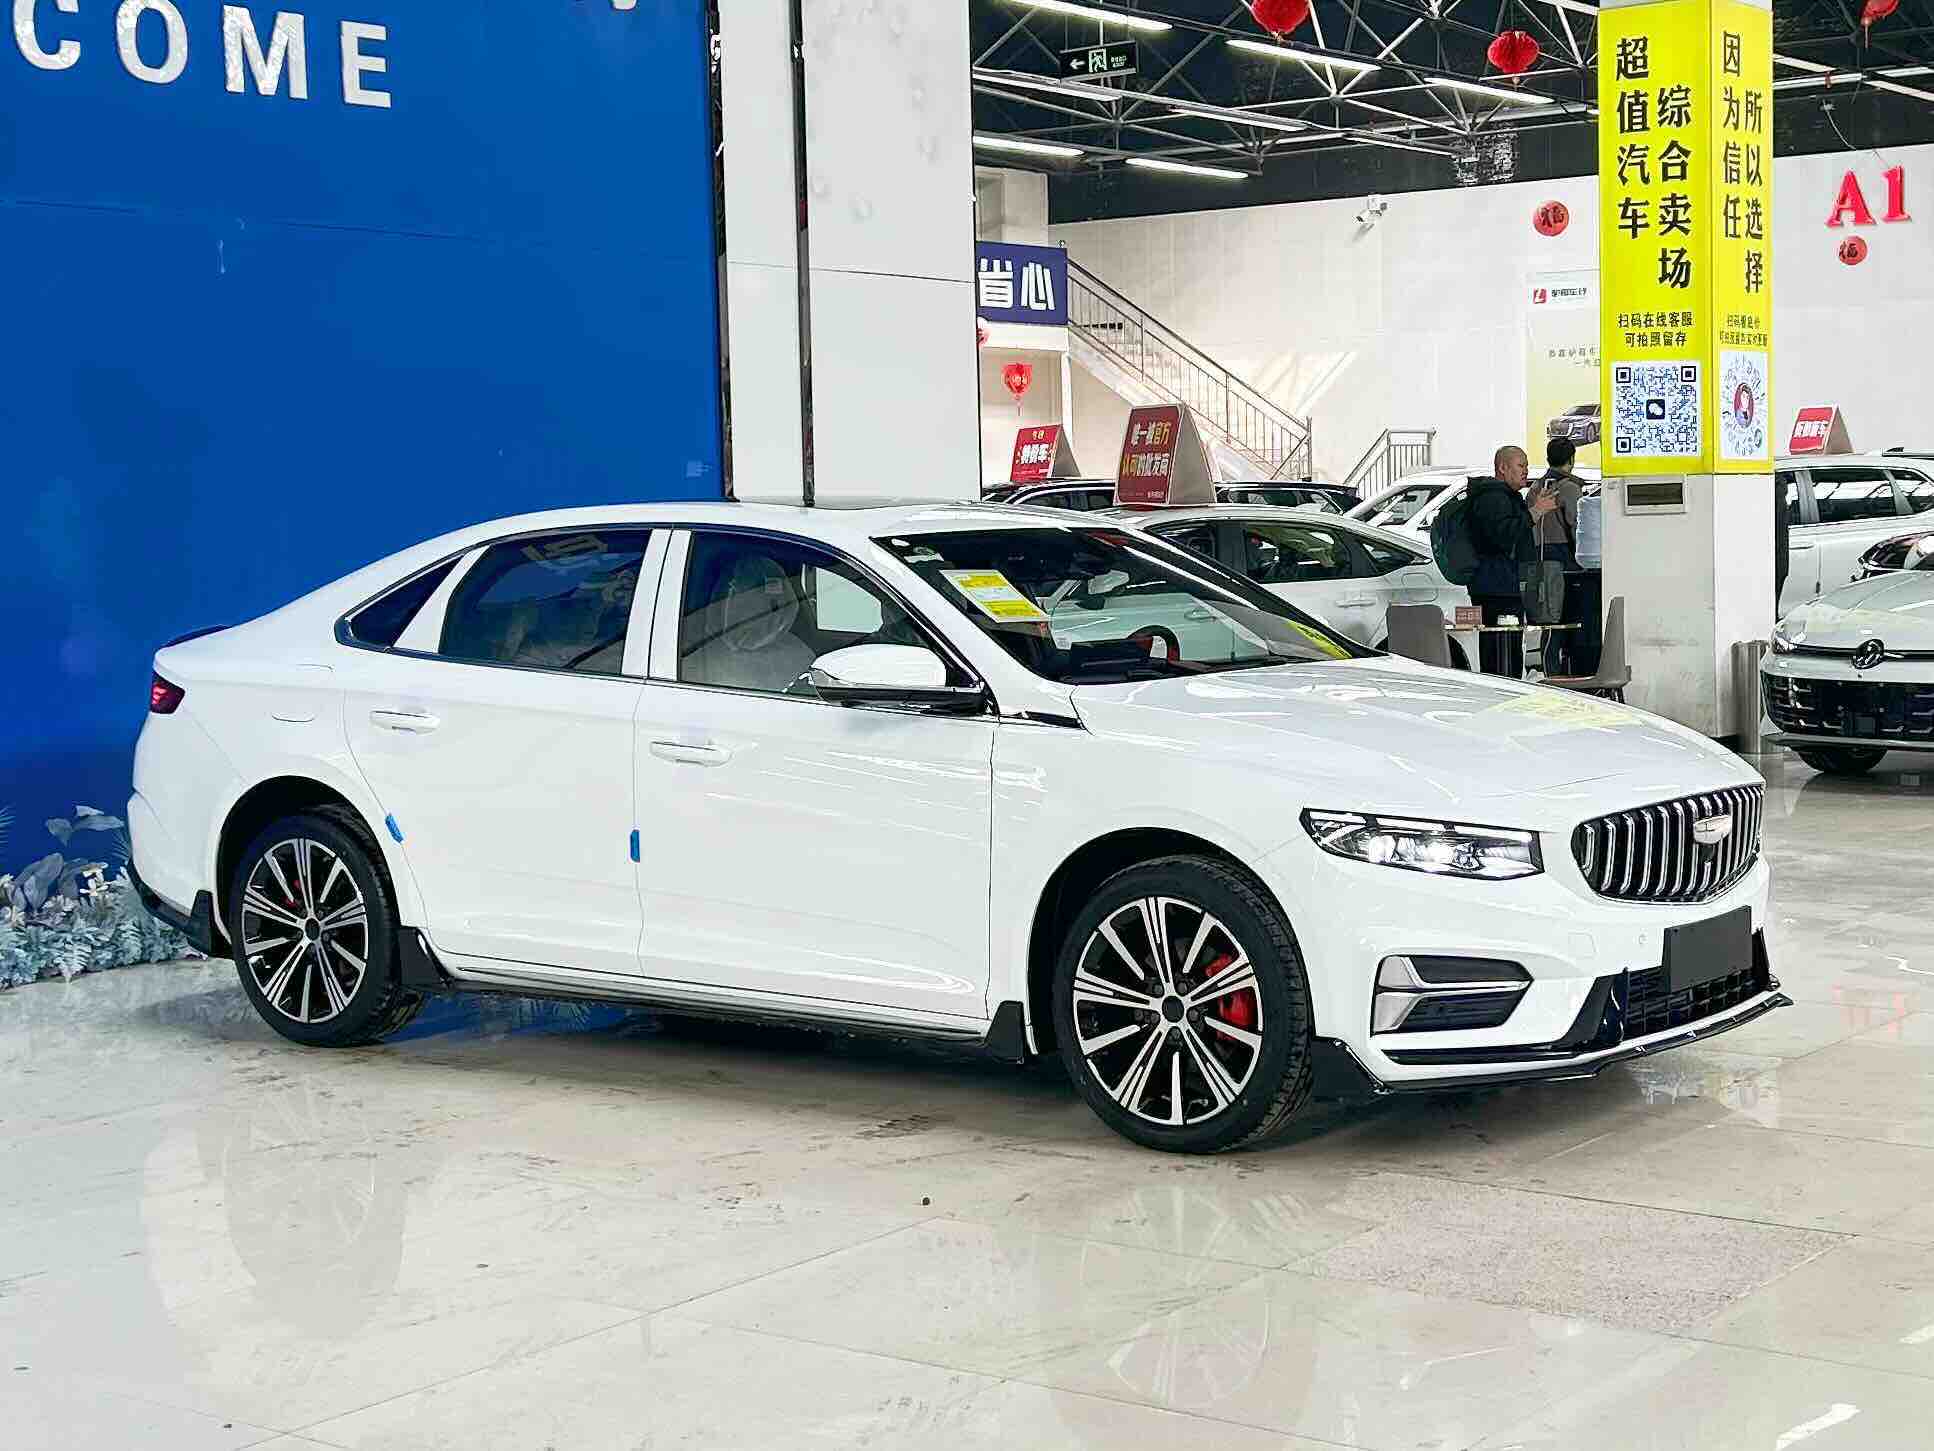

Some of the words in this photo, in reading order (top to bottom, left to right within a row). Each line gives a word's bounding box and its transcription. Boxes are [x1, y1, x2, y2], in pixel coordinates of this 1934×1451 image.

[13, 0, 391, 108] COME
[1616, 36, 1650, 239] 超值汽车
[1657, 84, 1692, 288] 综合卖场
[1723, 30, 1741, 240] 因为信任
[1745, 90, 1763, 293] 所以选择
[1825, 165, 1912, 228] A1
[978, 257, 1056, 312] 省心
[1617, 311, 1693, 329] 扫码在线客服
[1625, 331, 1687, 348] 可拍照留存
